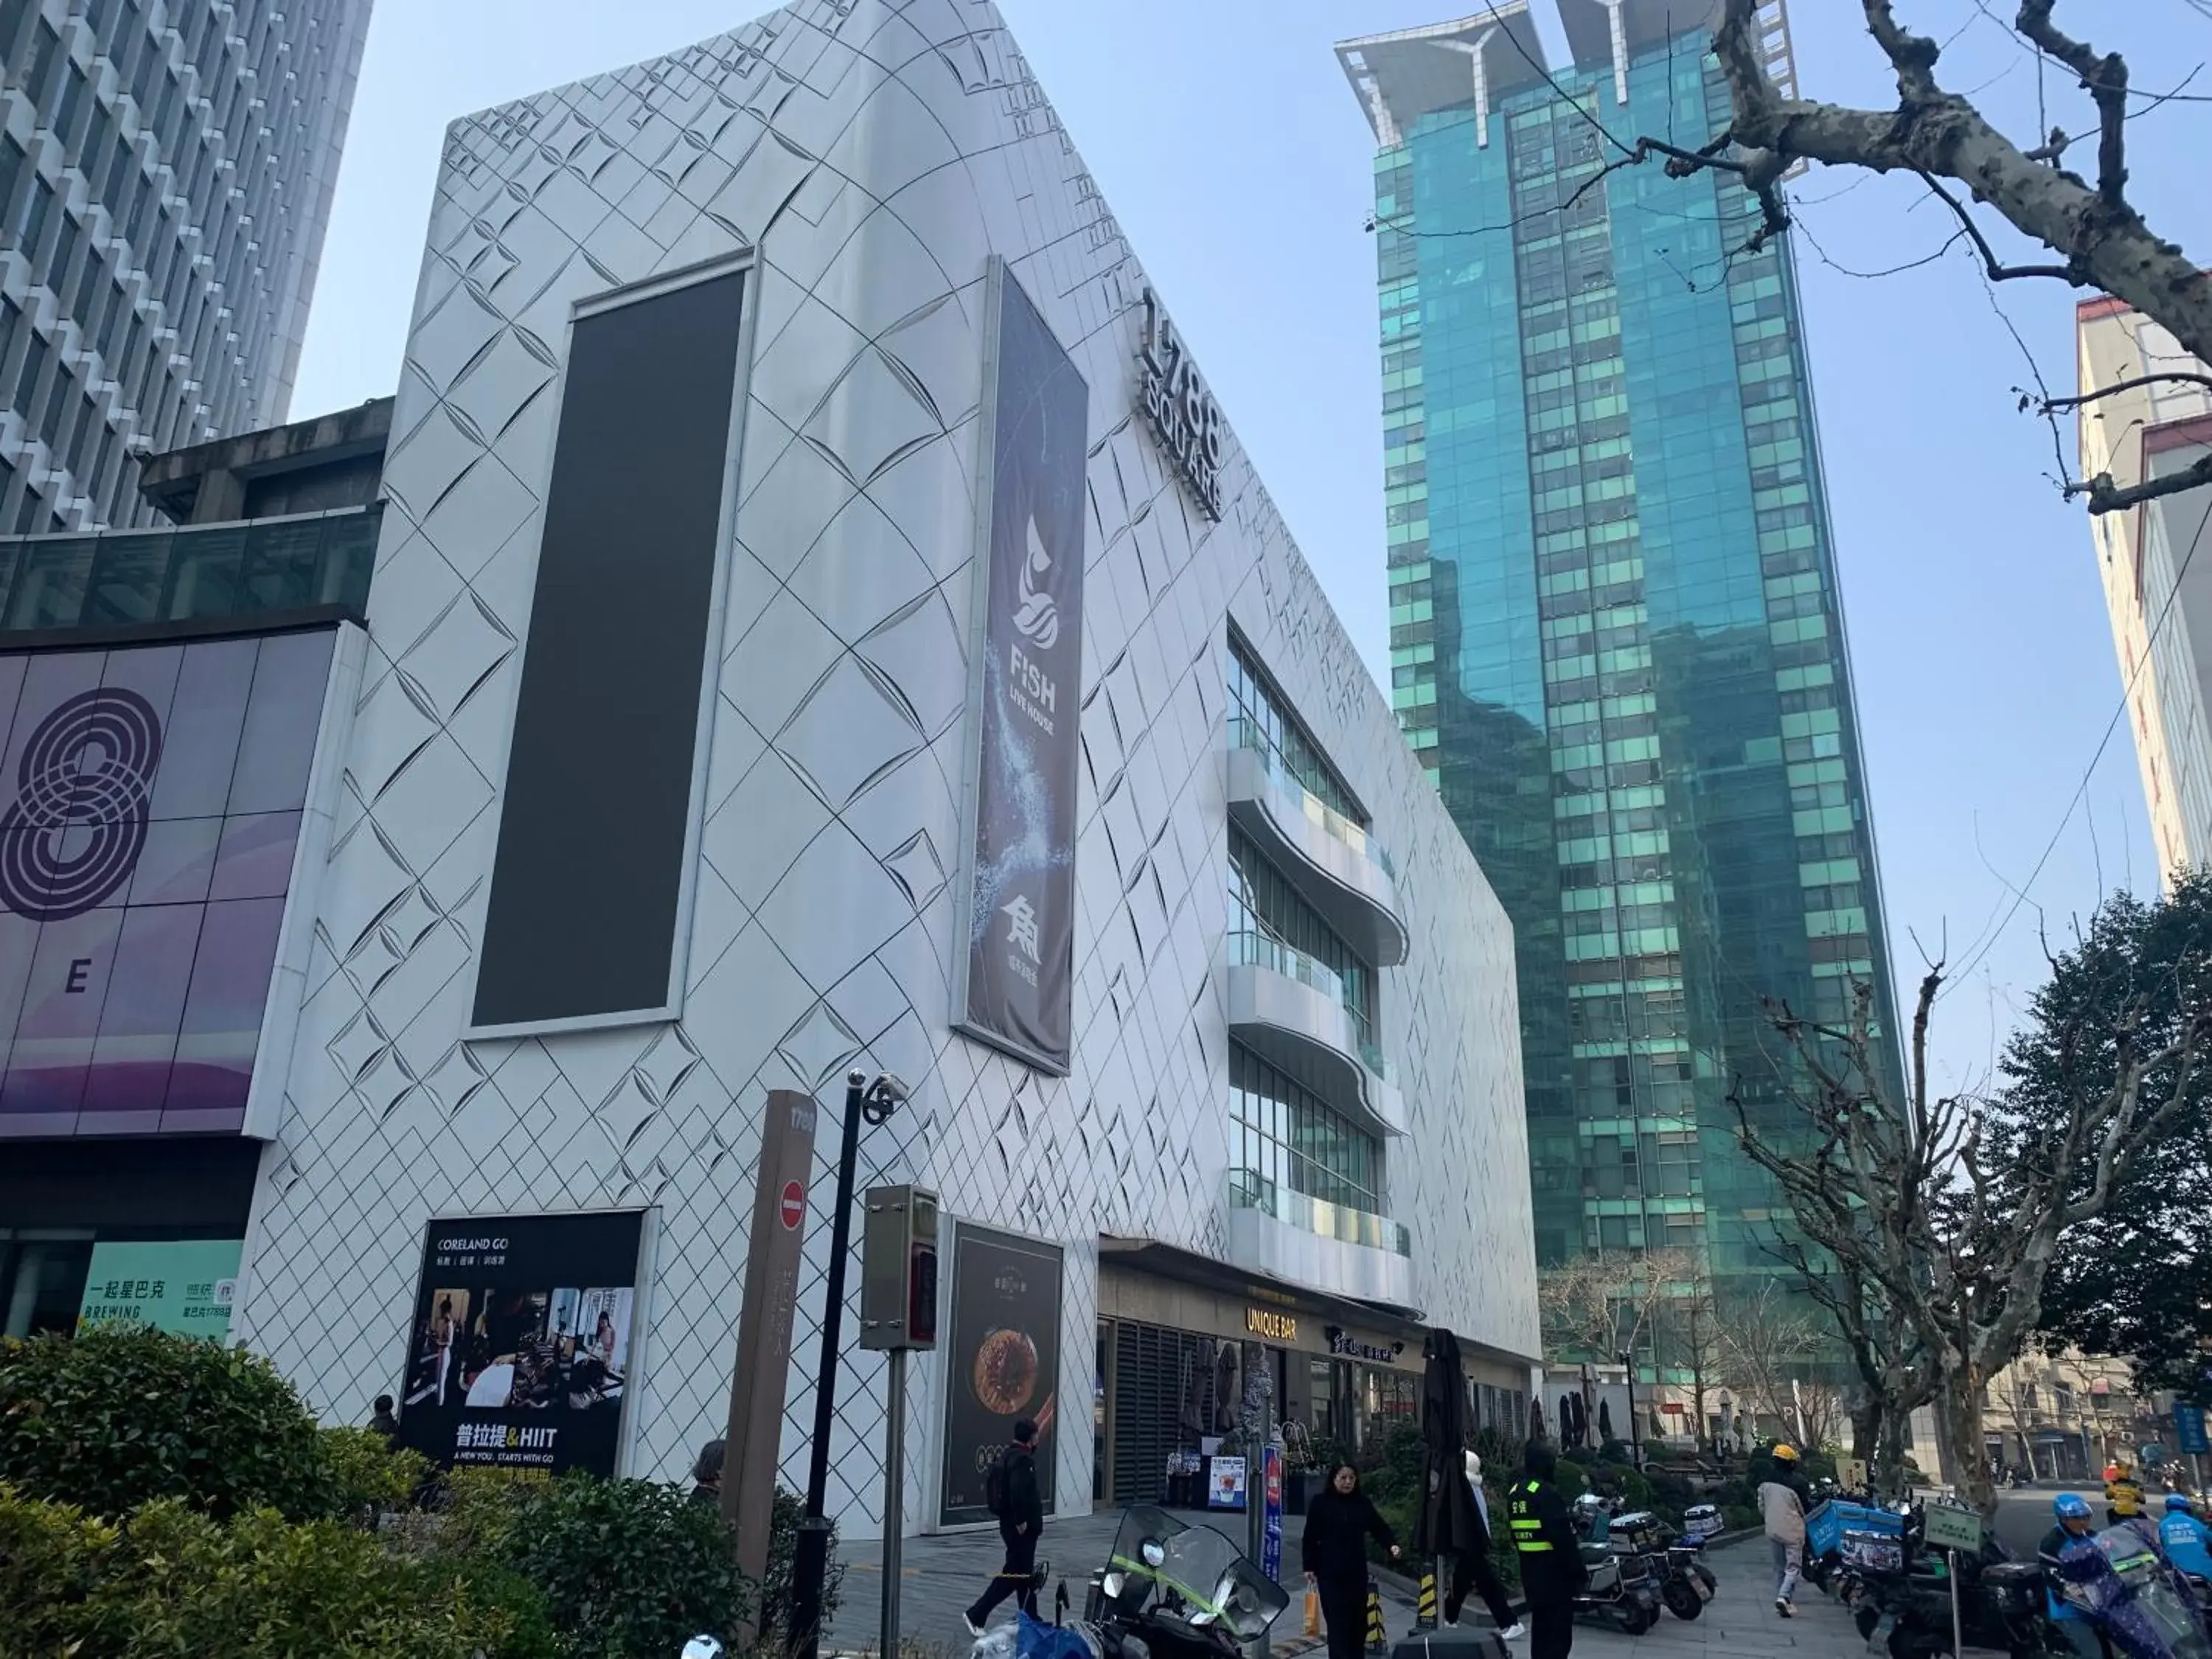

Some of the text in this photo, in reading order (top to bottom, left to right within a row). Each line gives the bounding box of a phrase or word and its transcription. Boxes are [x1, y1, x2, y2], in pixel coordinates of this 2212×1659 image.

[1142, 287, 1221, 470] 1788
[1141, 371, 1222, 523] SQUARE
[1010, 643, 1056, 714] FISH
[1009, 684, 1054, 736] LIVE HOUSE
[65, 958, 92, 994] E
[437, 1238, 509, 1251] CORELAND GO
[91, 1280, 166, 1299] 一起星巴克
[85, 1305, 142, 1319] BREWING
[1246, 1306, 1297, 1340] UNIQUE BAR
[456, 1424, 558, 1449] 普拉提&HIIT
[453, 1451, 459, 1460] A
[460, 1451, 476, 1460] NEW
[498, 1453, 521, 1462] STARTS
[523, 1453, 541, 1463] WITH
[542, 1454, 554, 1463] GO
